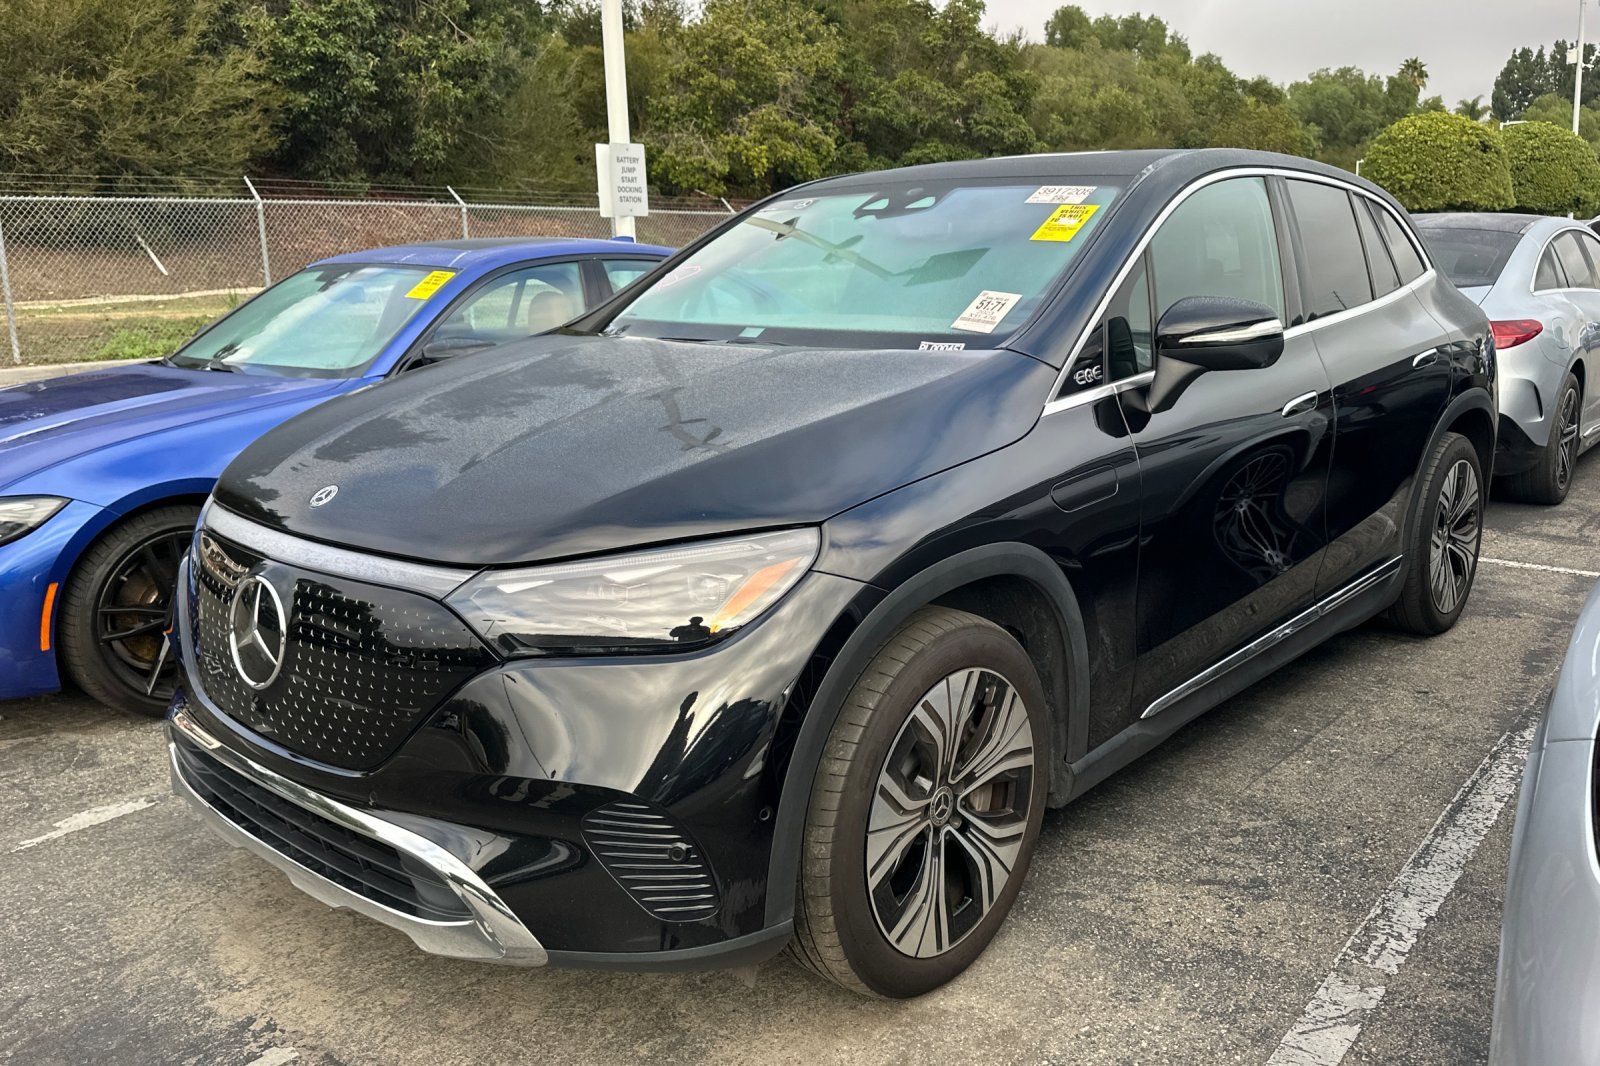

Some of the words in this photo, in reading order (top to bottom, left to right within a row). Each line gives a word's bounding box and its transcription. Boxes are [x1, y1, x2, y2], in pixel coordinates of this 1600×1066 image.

[616, 156, 640, 164] BATTERY
[621, 166, 636, 174] JUMP
[619, 195, 642, 203] STATION
[975, 299, 1007, 312] 51:71
[1073, 364, 1103, 385] EQE
